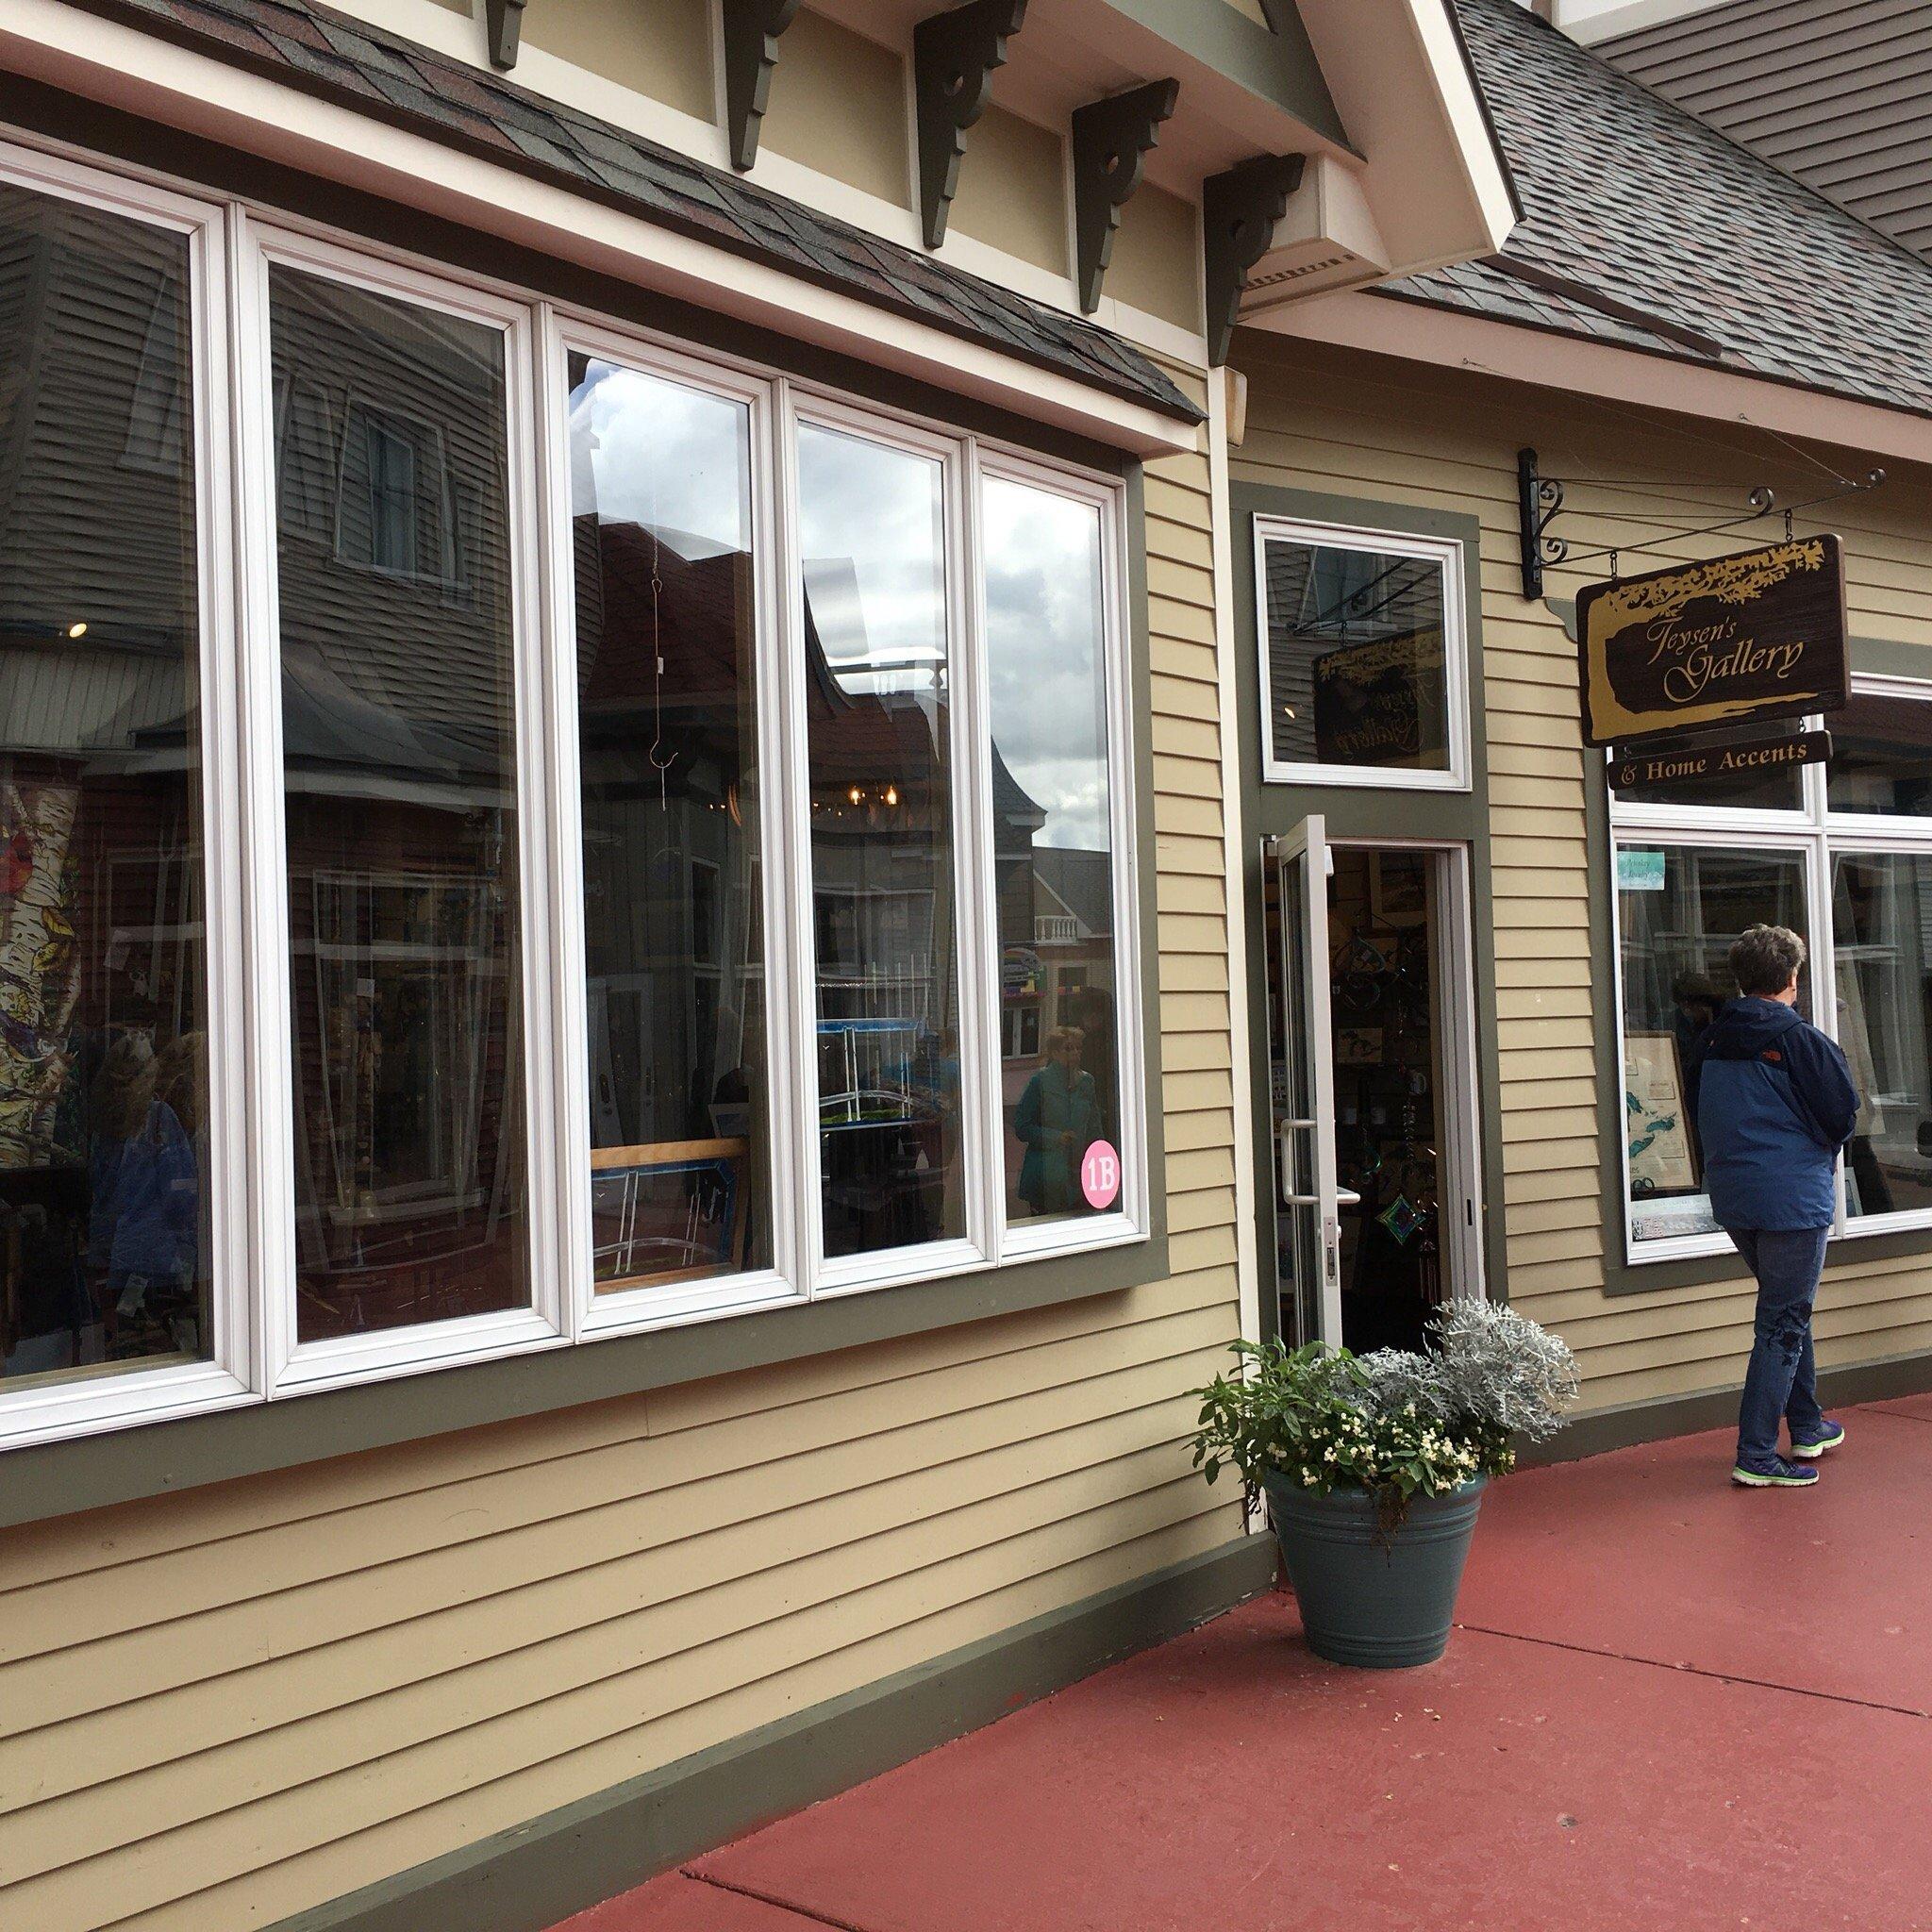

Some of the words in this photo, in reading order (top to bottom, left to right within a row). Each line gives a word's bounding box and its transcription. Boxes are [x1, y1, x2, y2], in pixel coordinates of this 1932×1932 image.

[1646, 615, 1738, 666] Teysen's
[1663, 638, 1804, 703] Gallery
[1621, 764, 1638, 785] &
[1646, 758, 1707, 781] Home
[1718, 743, 1807, 771] Accents
[1088, 1156, 1115, 1191] 1B
